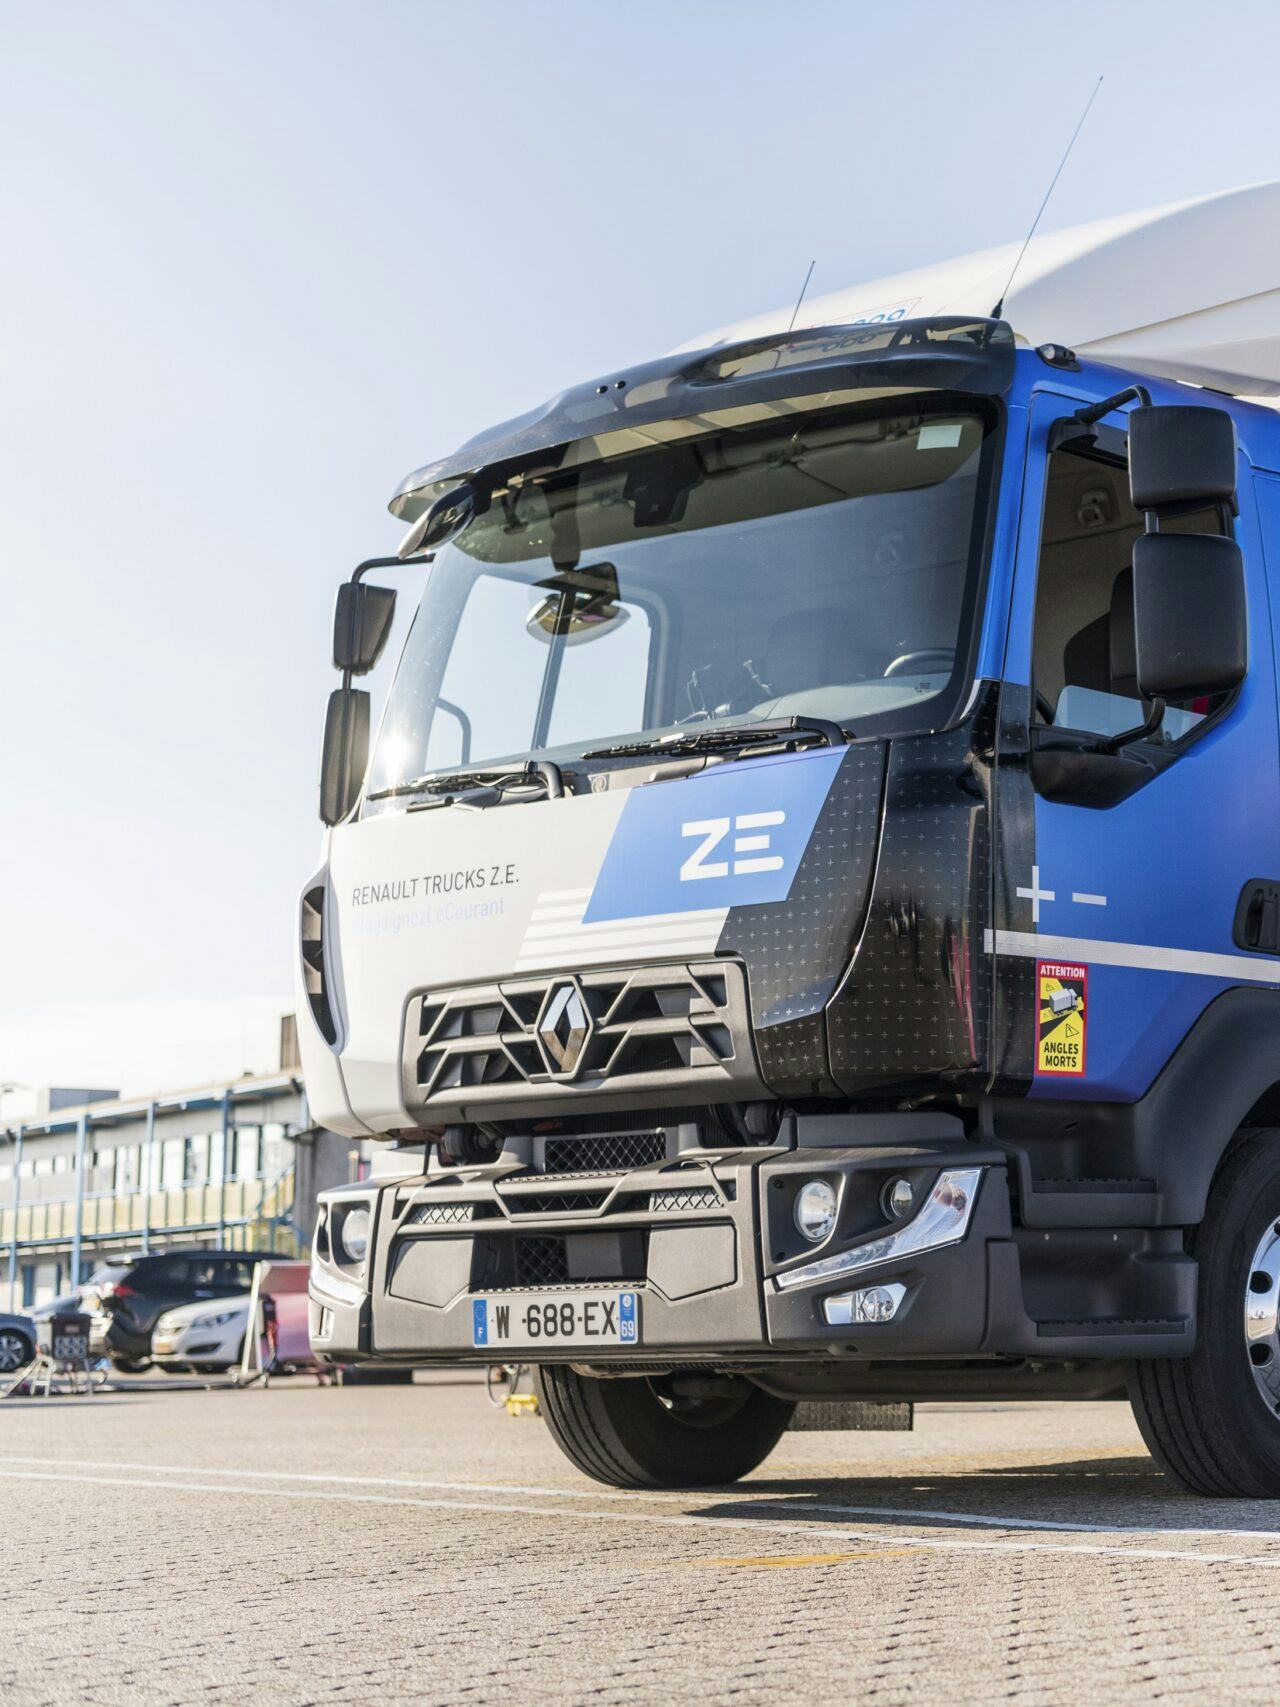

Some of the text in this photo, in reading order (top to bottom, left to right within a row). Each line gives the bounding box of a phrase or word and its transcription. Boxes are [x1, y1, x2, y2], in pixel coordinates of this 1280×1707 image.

[680, 810, 786, 881] ZE
[352, 864, 519, 907] RENAULT TRUCKS Z.E.
[1040, 965, 1085, 978] ATTENTION
[1044, 1042, 1079, 1054] ANGLES
[1045, 1055, 1077, 1068] MORTS
[478, 1327, 484, 1338] F
[621, 1320, 634, 1337] 69
